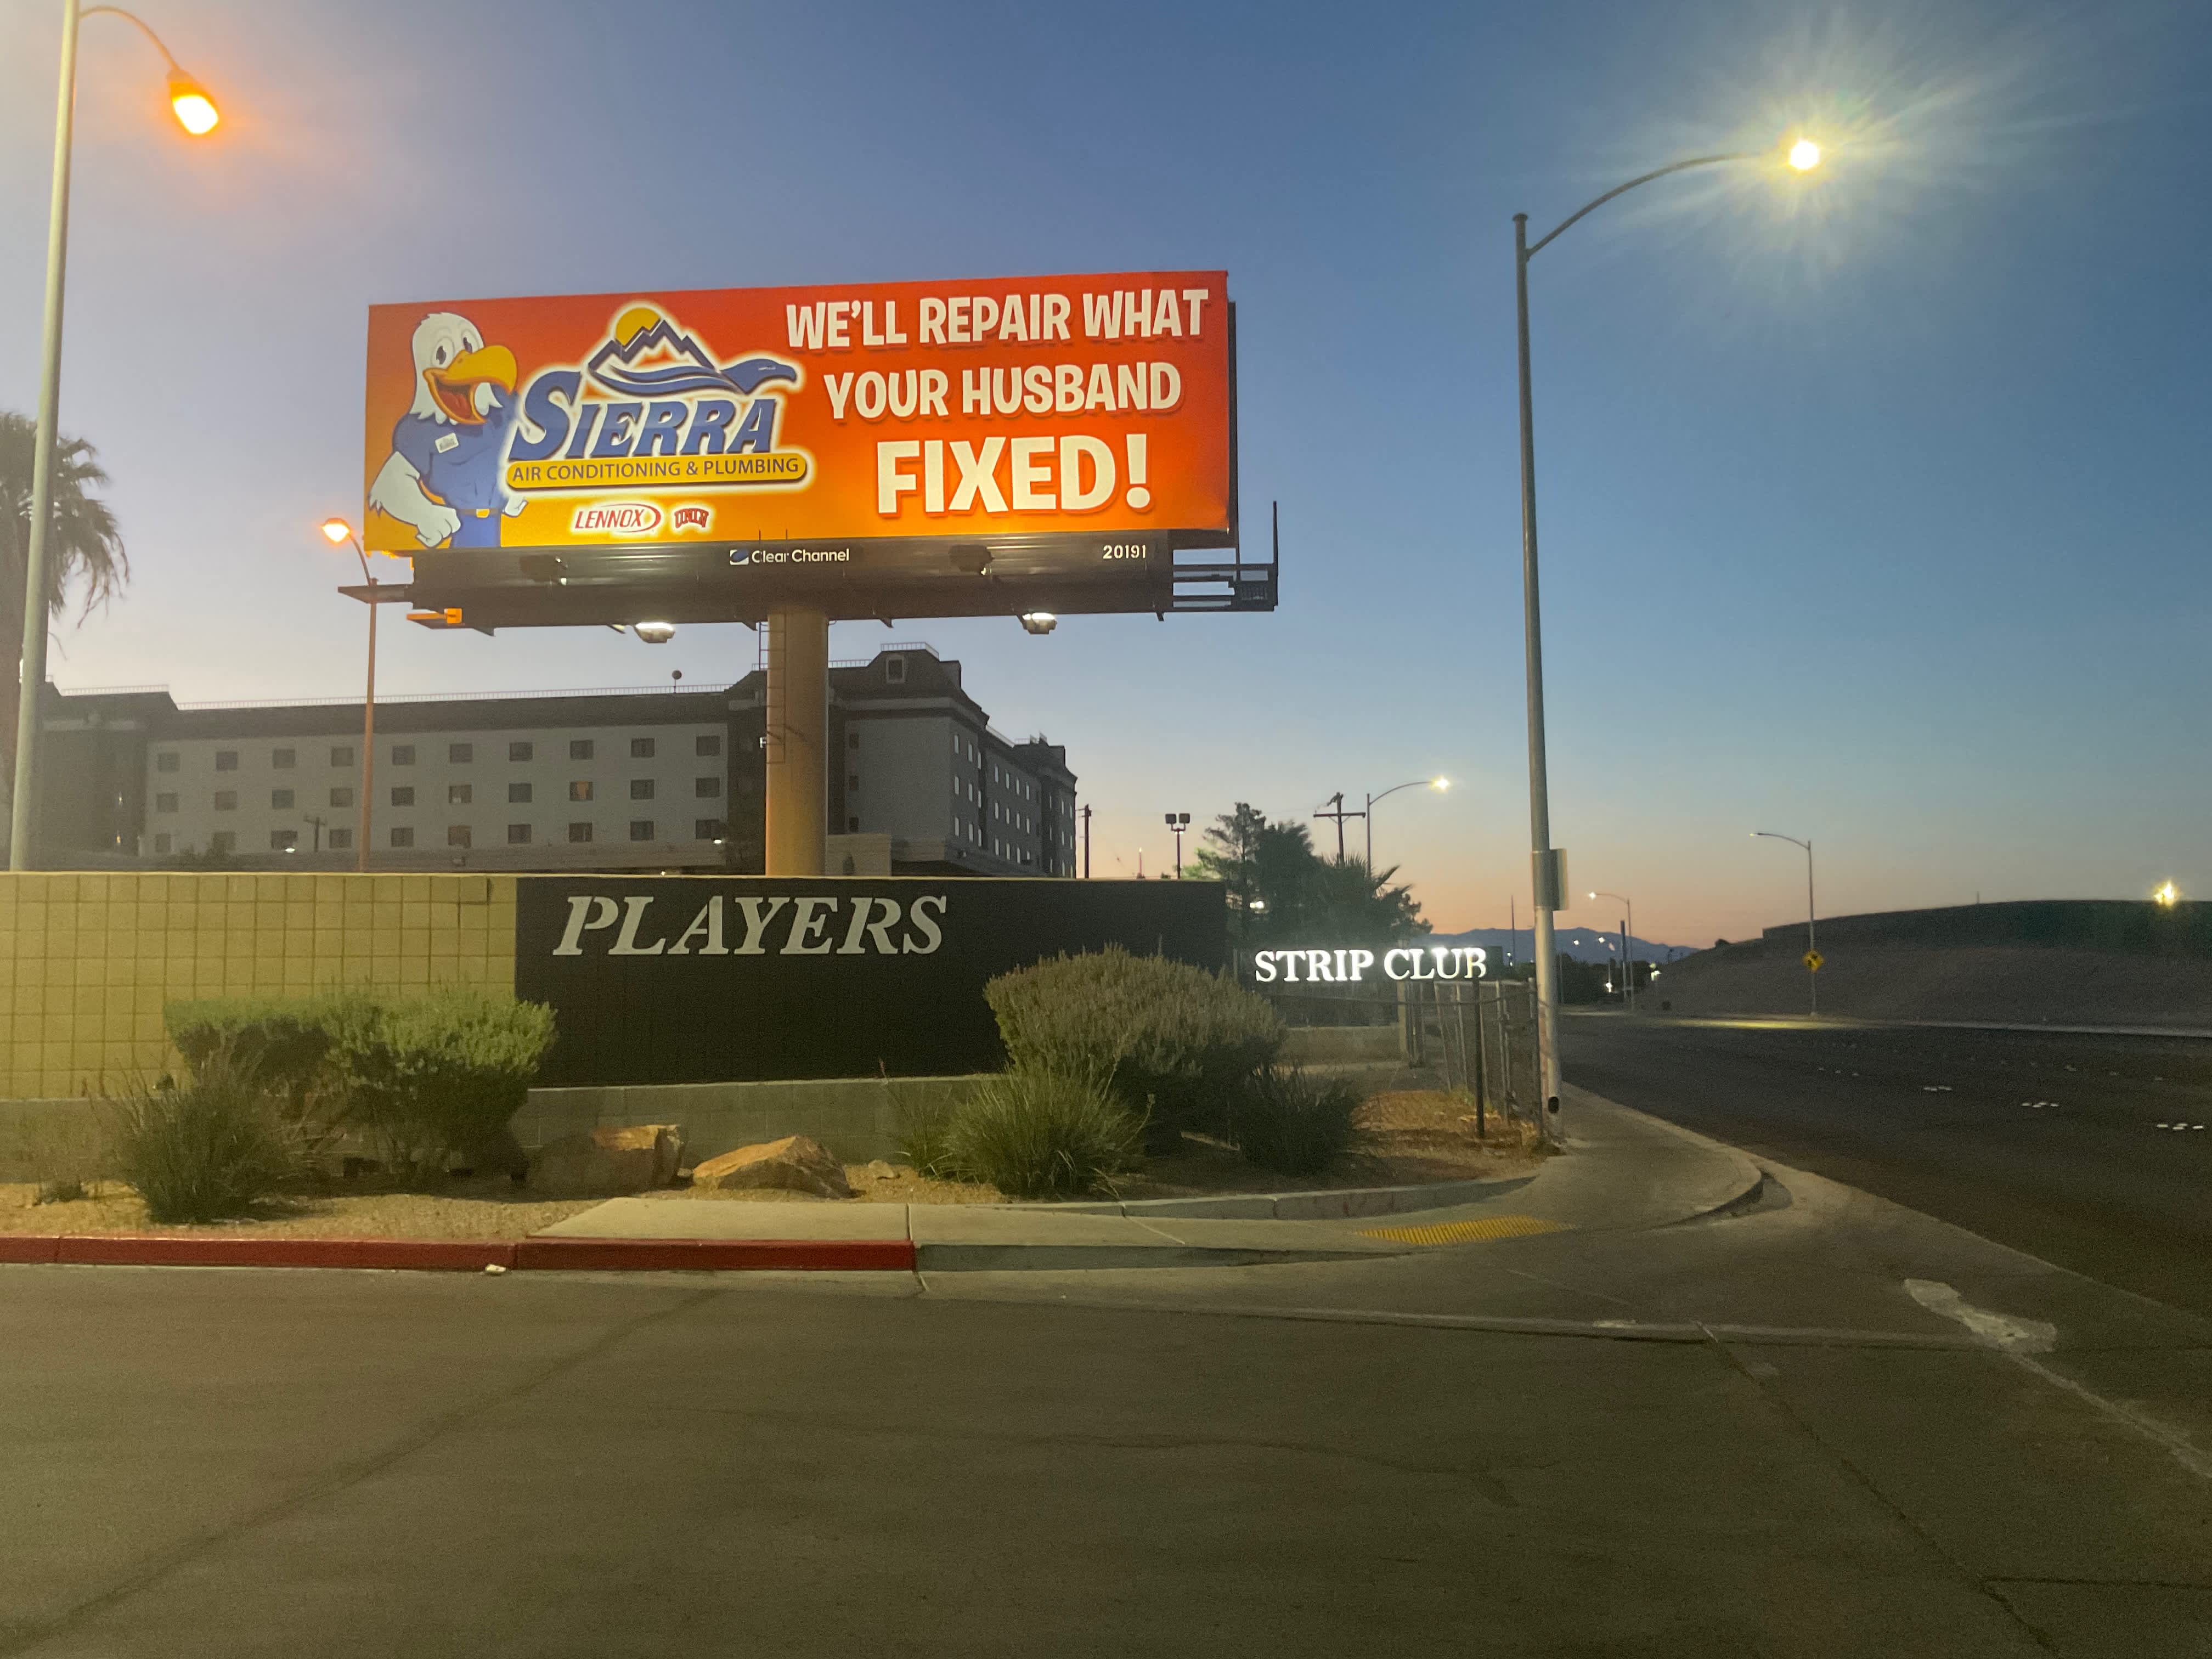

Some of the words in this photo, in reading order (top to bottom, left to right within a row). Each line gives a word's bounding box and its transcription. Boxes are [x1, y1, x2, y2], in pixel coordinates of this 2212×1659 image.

[786, 300, 907, 349] WE'LL
[920, 294, 1071, 345] REPAIR
[1083, 289, 1209, 339] WHAT
[823, 369, 948, 419] YOUR
[963, 362, 1182, 415] HUSBAND
[508, 370, 776, 461] SIERRA
[512, 466, 541, 482] AIR
[546, 461, 681, 481] CONDITIONING
[686, 461, 698, 475] &
[704, 458, 799, 475] PLUMBING
[877, 433, 1150, 514] FIXED!
[574, 509, 645, 529] LENNOX
[751, 549, 789, 563] Clear
[791, 548, 850, 563] Channel
[1103, 545, 1146, 559] 20191
[552, 894, 947, 956] PLAYERS
[1255, 949, 1374, 982] STRIP
[1383, 947, 1487, 980] CLUB
